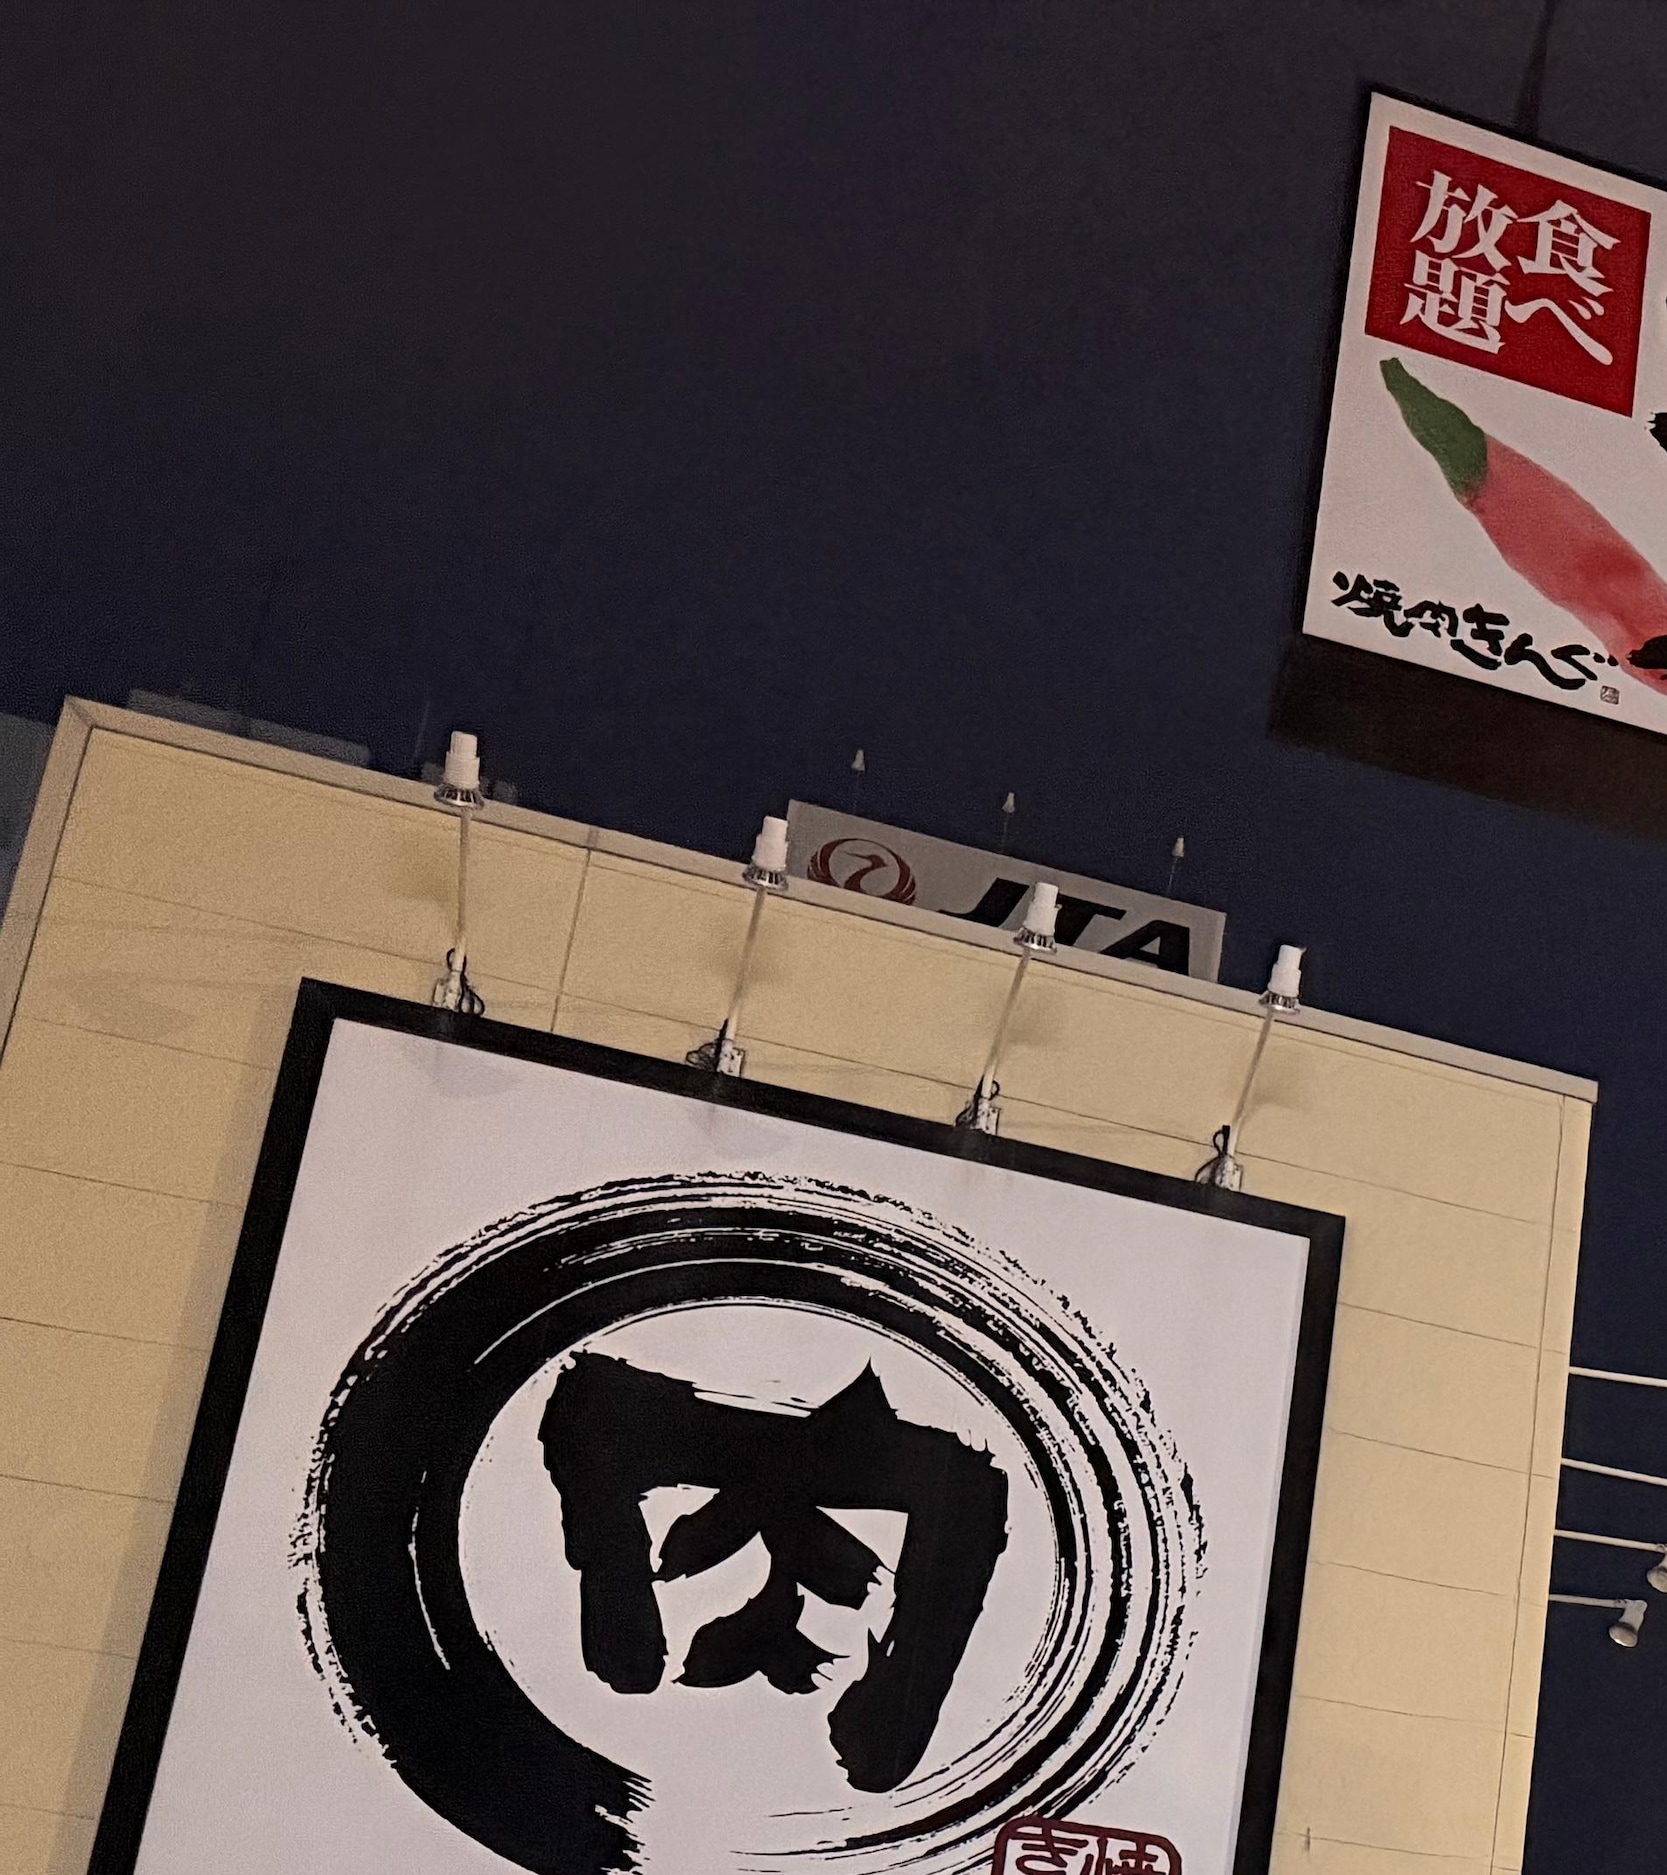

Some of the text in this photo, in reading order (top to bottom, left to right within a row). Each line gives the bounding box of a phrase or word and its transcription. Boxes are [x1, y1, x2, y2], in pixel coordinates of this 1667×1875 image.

[1400, 168, 1514, 355] 放題
[1504, 200, 1621, 366] 食べ
[937, 877, 1190, 976] JTA
[538, 1350, 1010, 1793] 肉
